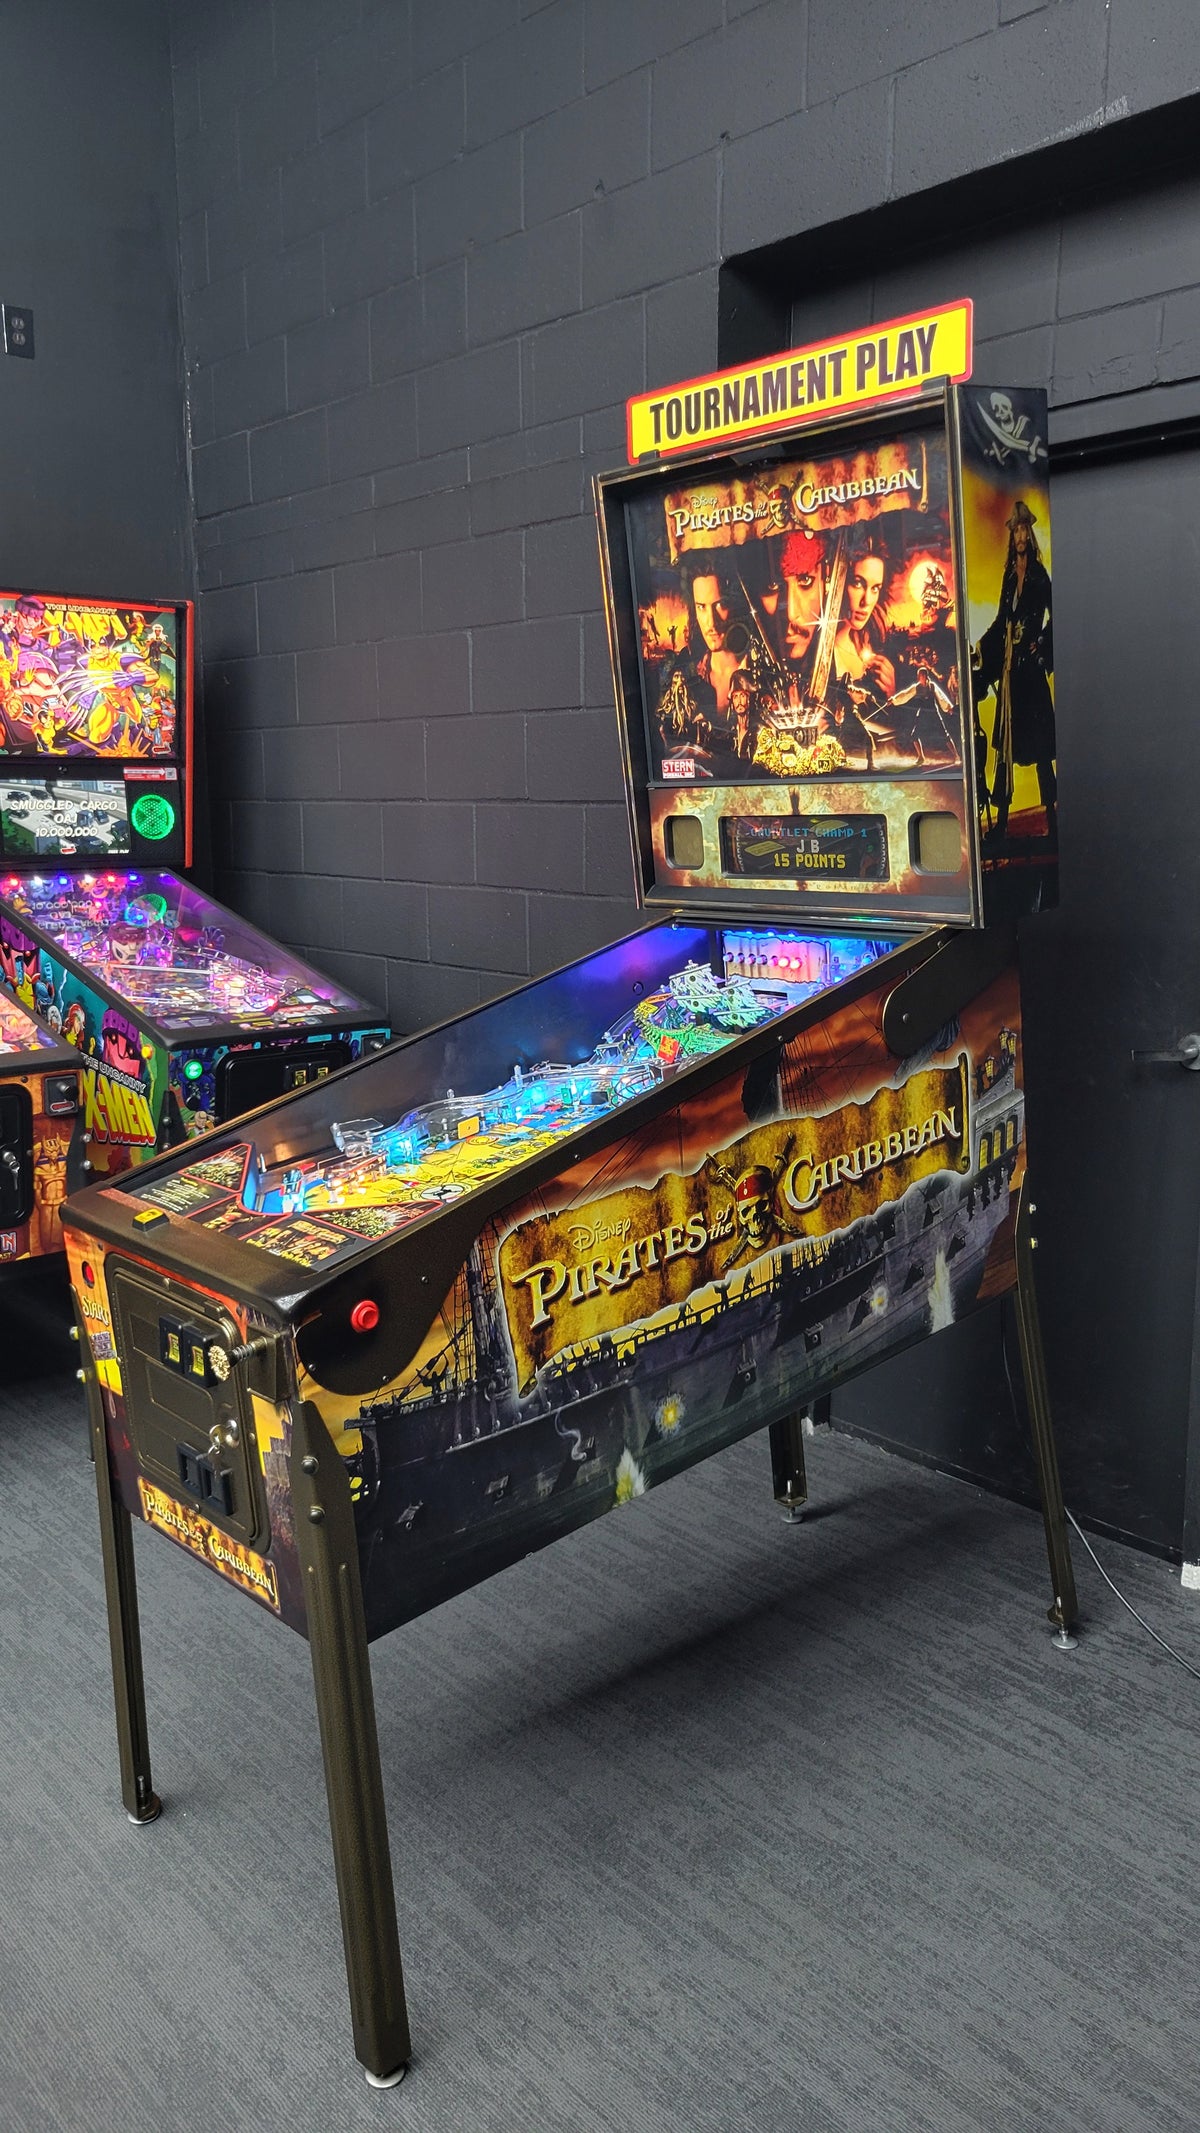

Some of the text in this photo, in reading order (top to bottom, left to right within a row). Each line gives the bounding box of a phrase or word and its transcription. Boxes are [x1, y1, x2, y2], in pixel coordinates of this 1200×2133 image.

[650, 323, 938, 444] TOURNAMENT PLAY
[669, 502, 755, 537] PIRATES
[794, 467, 922, 514] CARIBBEAN
[663, 761, 694, 772] STERN
[10, 800, 118, 811] SMUGGLED CARGO
[36, 827, 98, 838] 10,000,000
[750, 827, 867, 838] GAUNTLET CHAMP 1
[796, 840, 820, 854] J B
[774, 853, 846, 869] 15 POINTS
[80, 1051, 146, 1093] THE UNCANNY
[82, 1068, 157, 1146] X-MEN
[511, 1105, 962, 1331] PIRATES of the CARIBBEAN
[207, 1535, 275, 1597] CARIBBEAN
